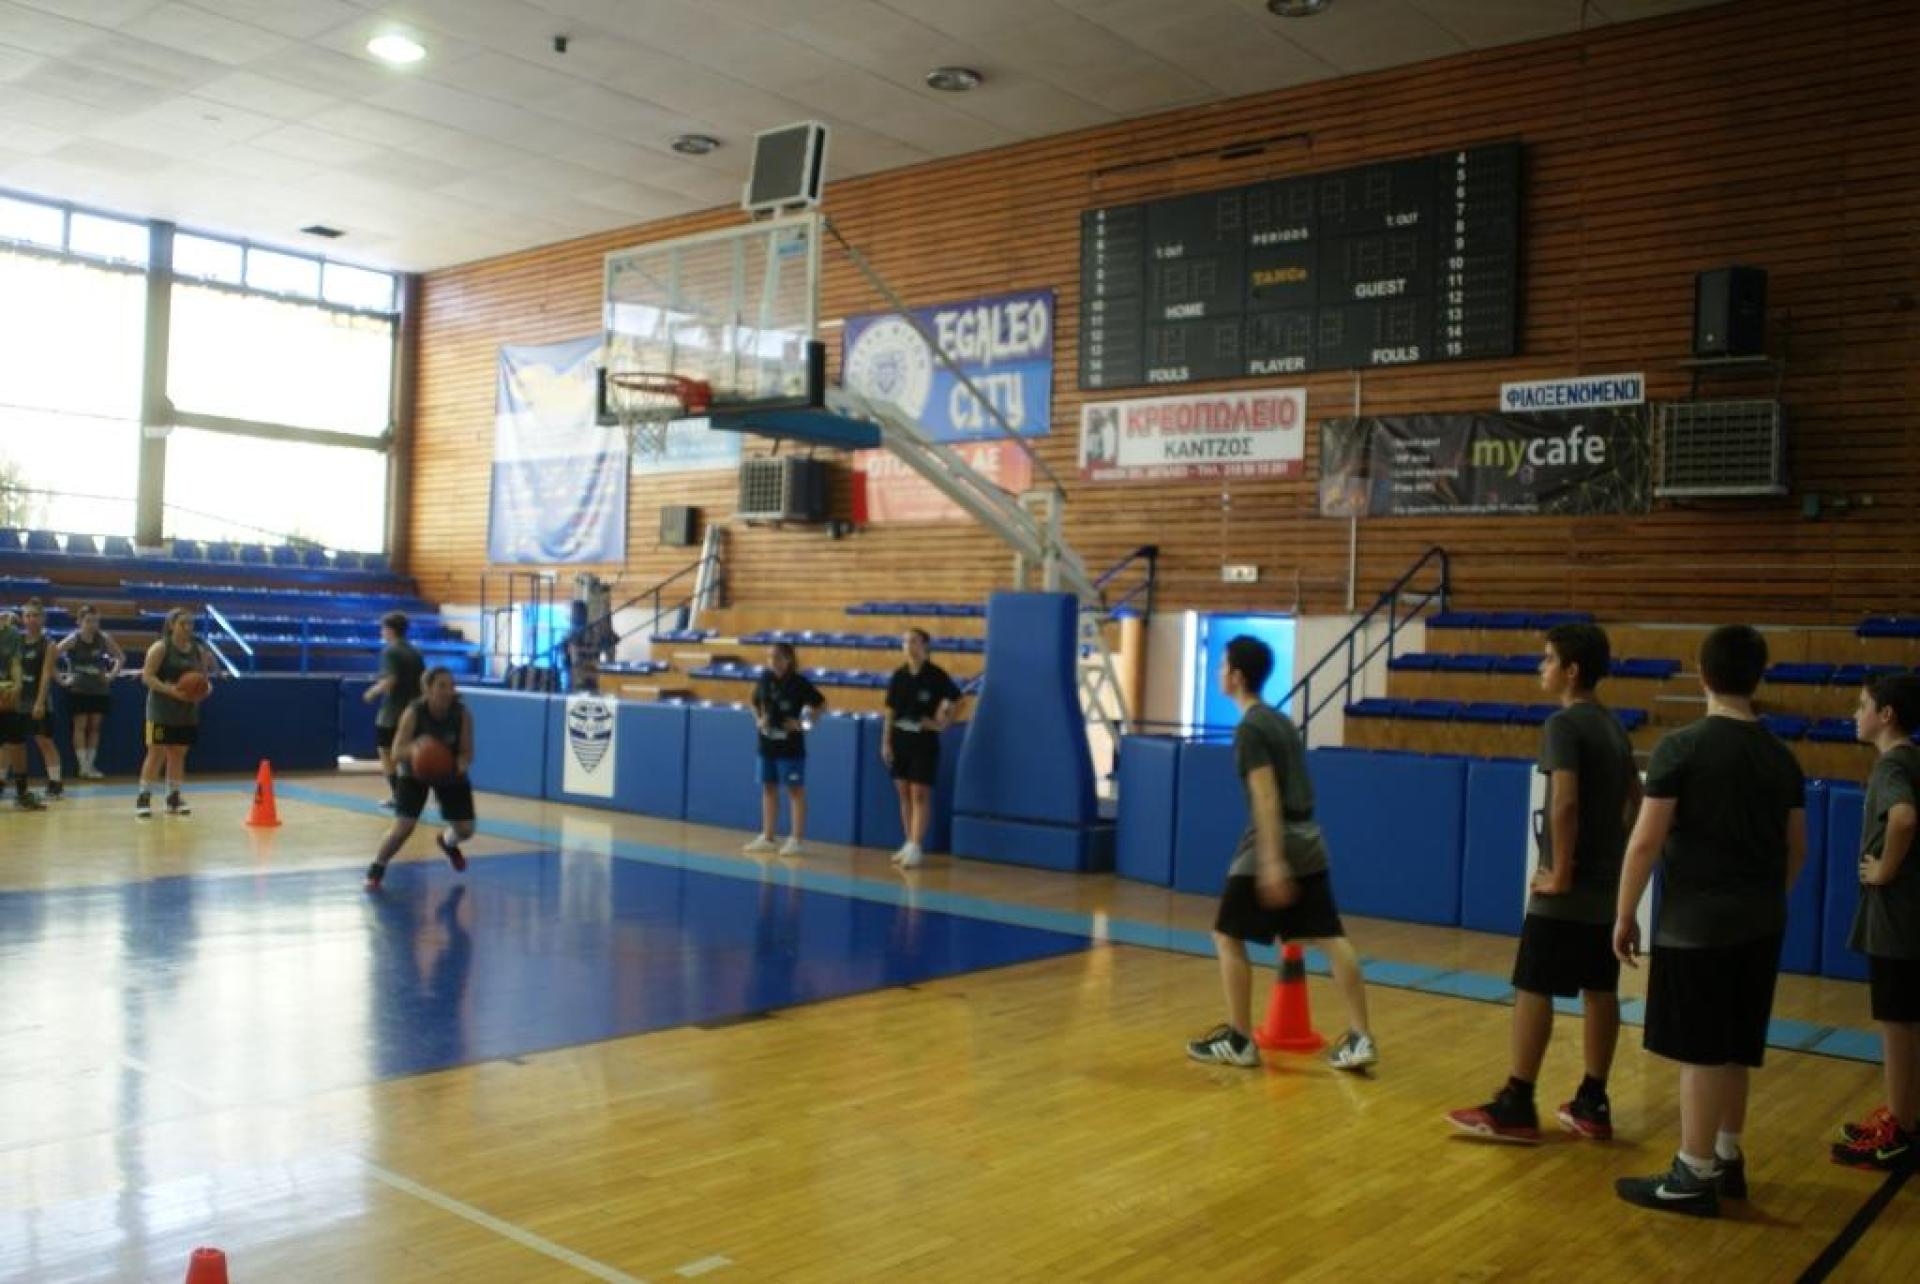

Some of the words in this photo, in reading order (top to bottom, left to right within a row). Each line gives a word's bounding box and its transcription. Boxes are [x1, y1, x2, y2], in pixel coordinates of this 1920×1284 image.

[1354, 278, 1407, 298] GUEST
[1165, 302, 1205, 319] HOME
[933, 299, 1050, 366] EGALEO
[1371, 346, 1419, 364] FOULS
[1249, 357, 1306, 375] PLAYER
[1163, 436, 1255, 459] ΚΑΝΤΖΟΣ
